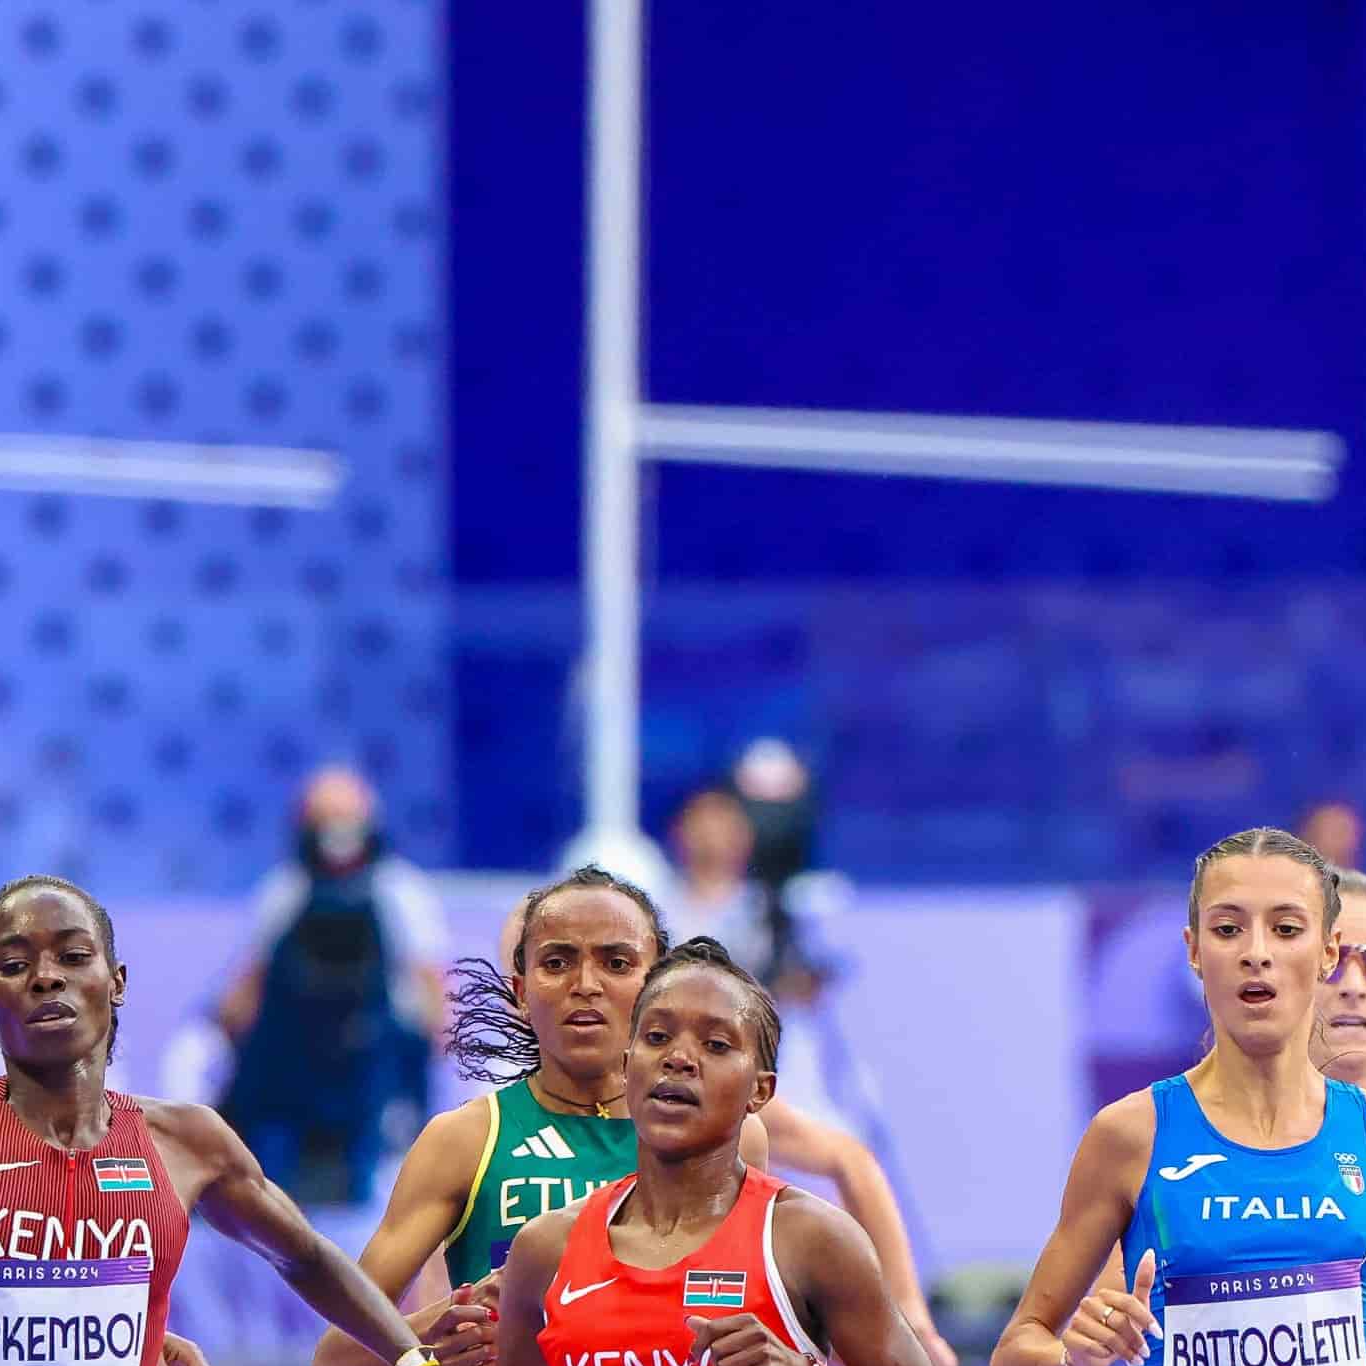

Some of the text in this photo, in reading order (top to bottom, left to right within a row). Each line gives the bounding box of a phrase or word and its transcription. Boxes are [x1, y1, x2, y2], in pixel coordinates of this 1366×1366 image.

[1201, 1196, 1347, 1220] ITALIA
[52, 1266, 99, 1280] 2024
[1210, 1273, 1315, 1295] PARIS 2024
